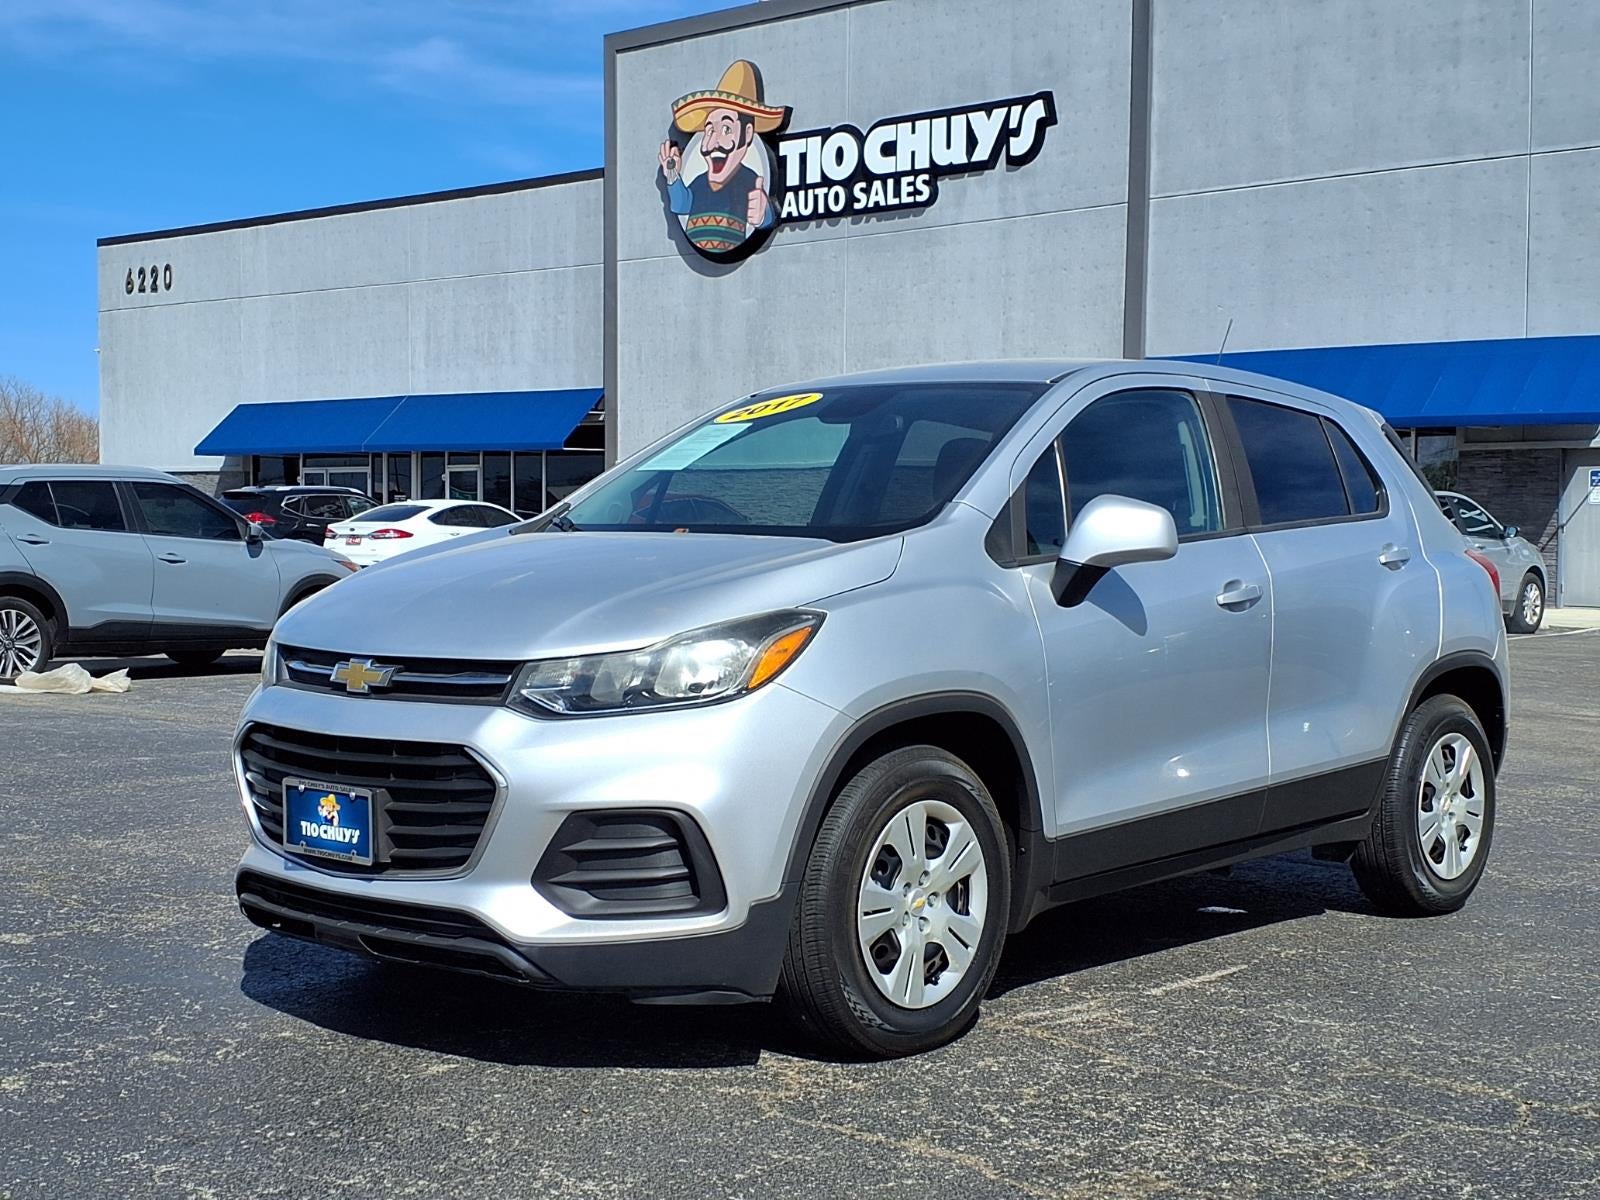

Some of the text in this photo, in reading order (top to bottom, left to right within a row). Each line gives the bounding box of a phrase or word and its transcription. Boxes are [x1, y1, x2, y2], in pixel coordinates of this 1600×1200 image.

[779, 98, 1046, 187] TIO CHUY'S
[780, 174, 931, 218] AUTO SALES
[125, 263, 172, 295] 6220
[723, 395, 812, 421] 2017
[300, 820, 360, 844] TIO CHUY'S
